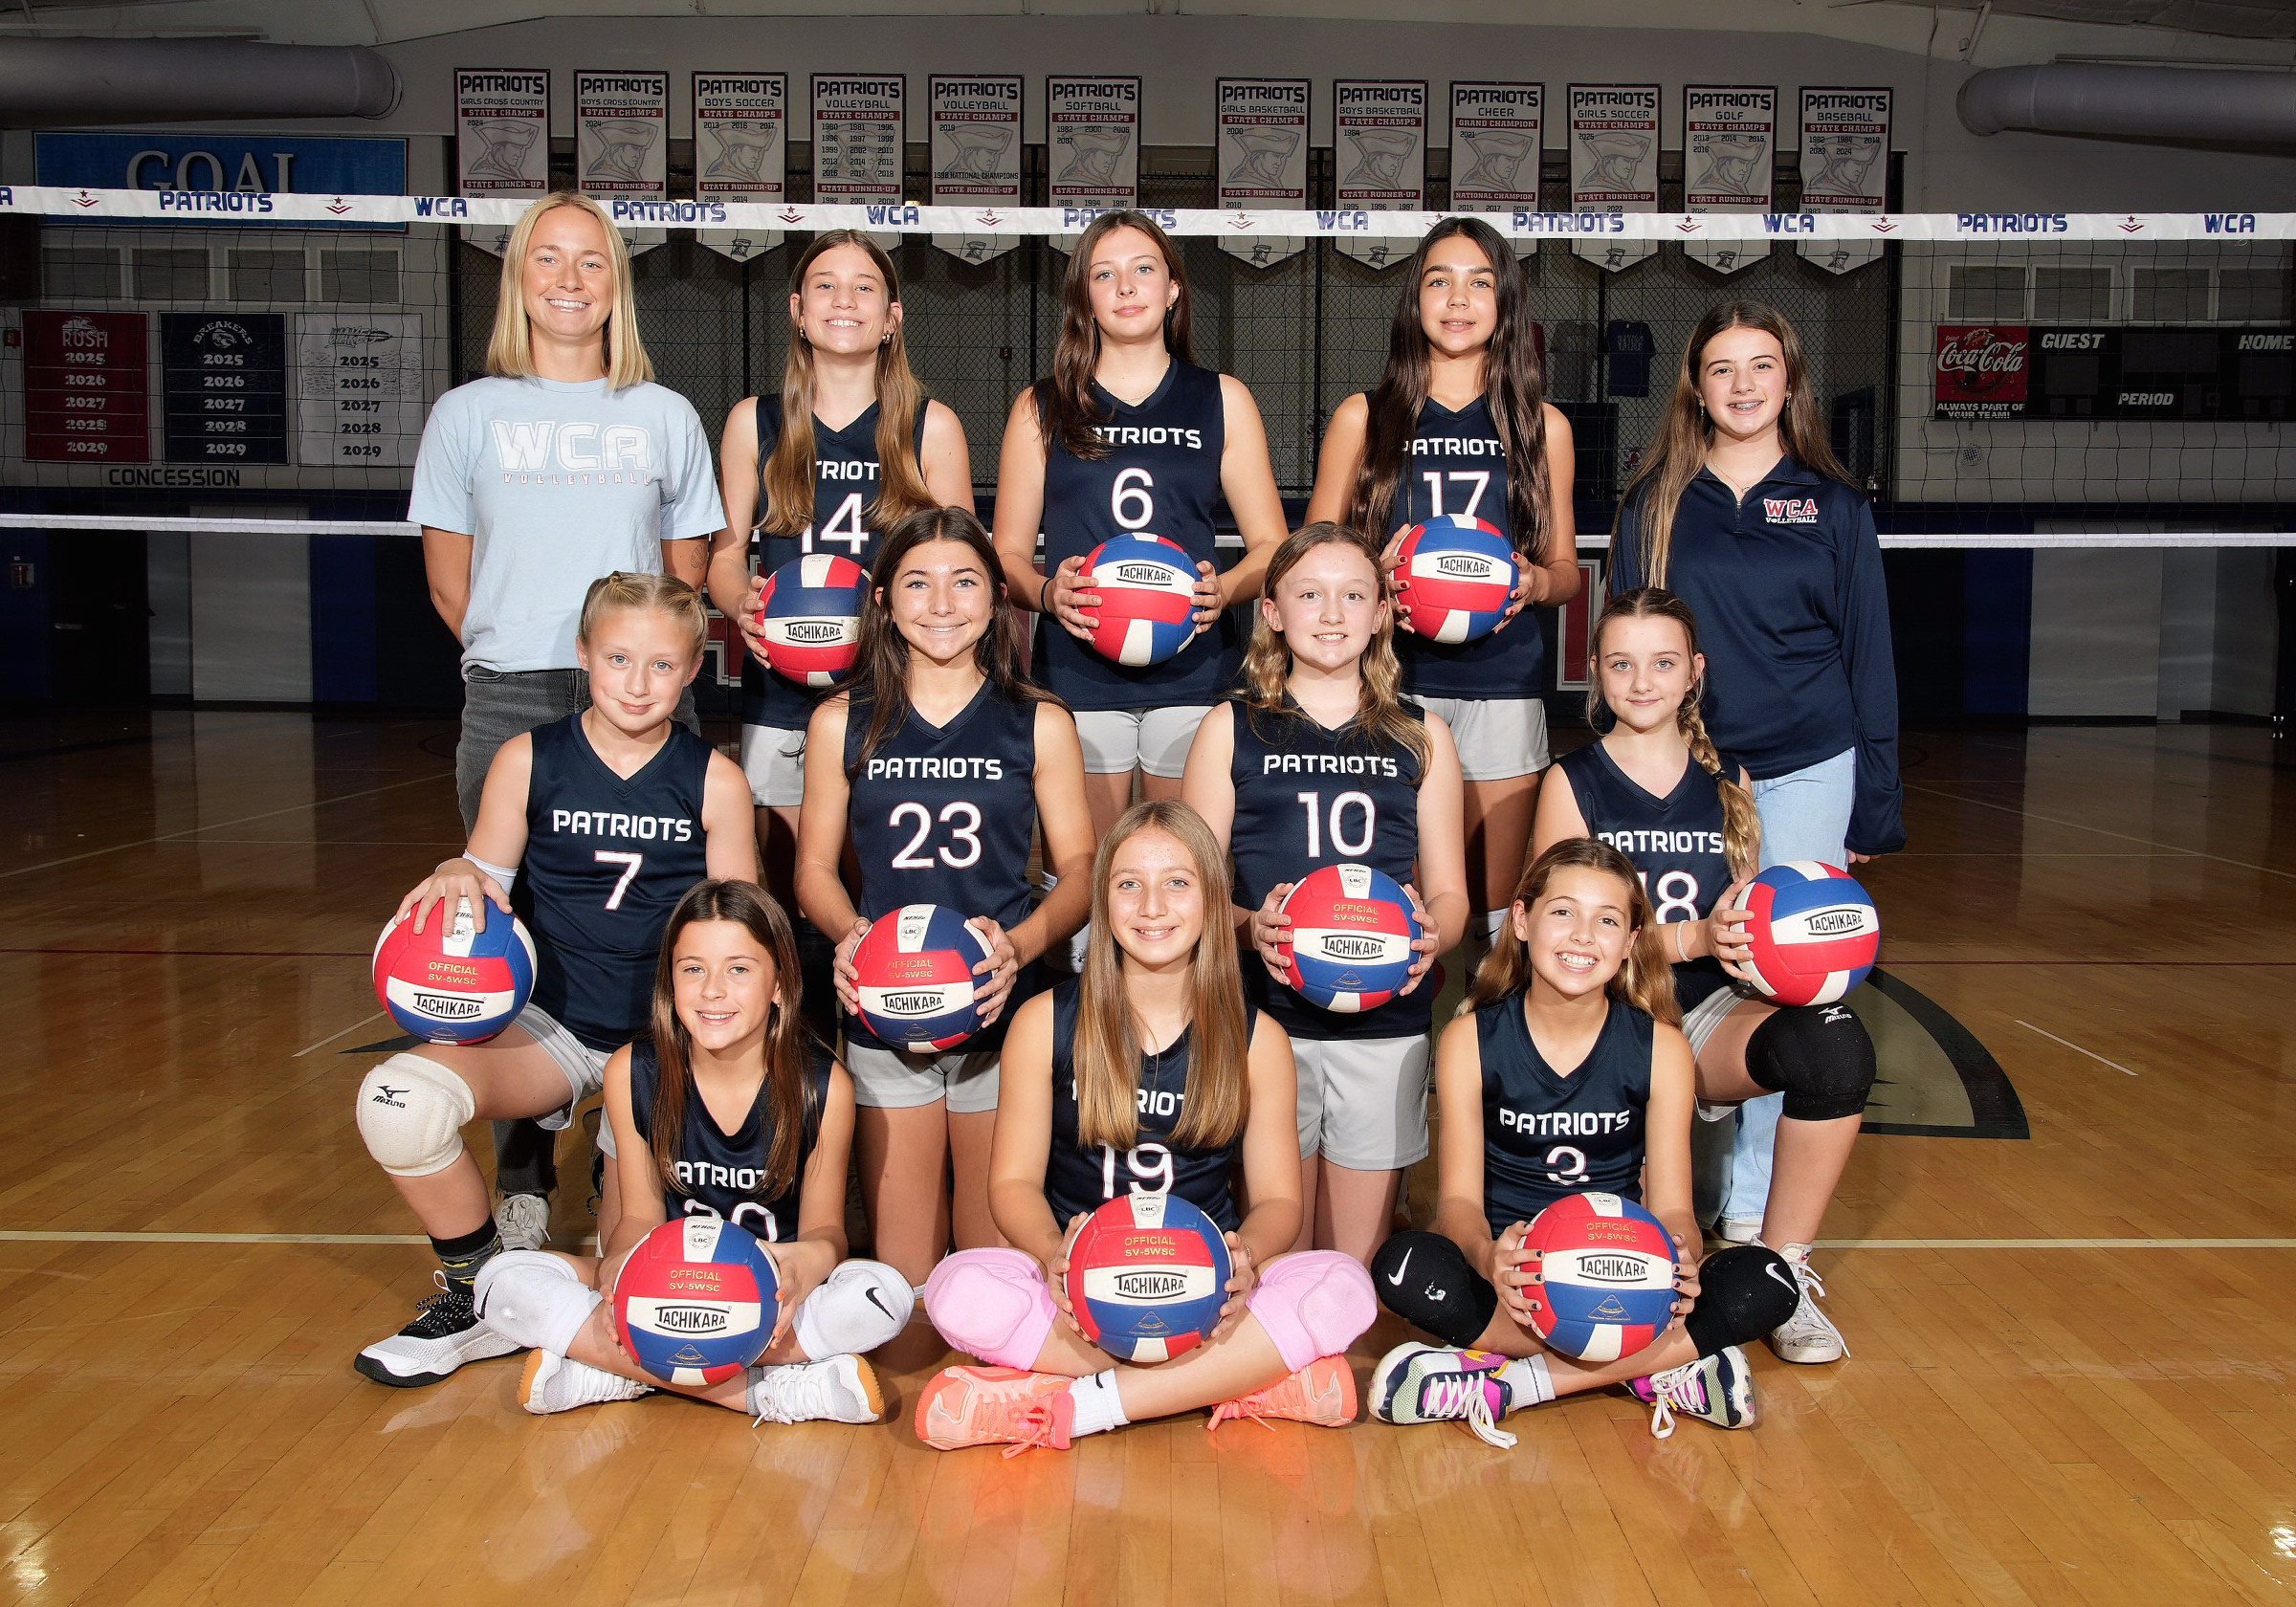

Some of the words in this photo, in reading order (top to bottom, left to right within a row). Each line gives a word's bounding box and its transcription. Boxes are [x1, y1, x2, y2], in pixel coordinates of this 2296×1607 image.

[460, 76, 544, 95] PATRIOTS
[581, 77, 663, 96] PATRIOTS
[698, 79, 782, 98] PATRIOTS
[817, 81, 899, 99] PATRIOTS
[935, 82, 1018, 99] PATRIOTS
[1052, 83, 1136, 101] PATRIOTS
[1222, 85, 1305, 103] PATRIOTS
[704, 99, 732, 107] BOYS
[736, 99, 775, 107] SOCCER
[826, 99, 890, 108] VOLLEYBALL
[1339, 87, 1423, 105] PATRIOTS
[1456, 89, 1538, 107] PATRIOTS
[1573, 91, 1656, 109] PATRIOTS
[1689, 93, 1772, 111] PATRIOTS
[1805, 95, 1888, 112] PATRIOTS
[499, 109, 538, 118] CHAMPS
[585, 108, 616, 117] STATE
[943, 100, 1008, 110] VOLLEYBALL
[1065, 101, 1121, 111] SOFTBALL
[1248, 105, 1305, 114] BASKETBALL
[1478, 107, 1514, 117] CHEER
[1610, 110, 1650, 119] SOCCER
[1715, 112, 1744, 121] GOLF
[1818, 113, 1873, 121] BASEBALL
[159, 191, 274, 212] PATRIOTS
[414, 197, 469, 218] WCA
[612, 201, 727, 222] PATRIOTS
[867, 206, 919, 227] WCA
[1064, 209, 1177, 230] PATS
[1316, 210, 1369, 231] WCA
[1512, 212, 1624, 232] PATRIOTS
[1762, 213, 1815, 233] WCA
[1956, 213, 2068, 233] PATRIOTS
[2204, 213, 2256, 233] WCA
[193, 320, 253, 344] BREAKERS
[2042, 333, 2106, 349] GUEST
[2239, 335, 2294, 350] HOME
[65, 352, 105, 364] 2025
[203, 354, 244, 365] 2025
[340, 356, 380, 367] 2025
[204, 376, 245, 387] 2026
[341, 378, 381, 389] 2026
[65, 397, 106, 409] 2027
[204, 398, 245, 410] 2027
[341, 401, 381, 412] 2027
[1937, 403, 1978, 411] ALWAYS
[1981, 403, 2009, 411] PART
[2012, 403, 2026, 411] OF
[2118, 392, 2175, 406] PERIOD
[206, 421, 247, 431] 2028
[342, 423, 381, 434] 2028
[490, 420, 651, 473] WCA
[1093, 427, 1203, 450] TRIOTS
[207, 443, 247, 455] 2029
[342, 446, 382, 457] 2029
[108, 468, 240, 487] CONCESSION
[815, 461, 882, 480] RIOT
[503, 473, 651, 486] VOLLEYBALL
[1112, 467, 1155, 530] 6
[1423, 470, 1490, 517] 17
[1763, 498, 1819, 517] WCA
[1117, 564, 1173, 583] TACHIKARA
[1437, 556, 1492, 575] TACHIKARA
[784, 622, 843, 640] TACHIKARA
[868, 758, 1004, 781] PATRIOTS
[1264, 754, 1399, 778] PATRIOTS
[552, 809, 693, 842] PATRIOTS
[1297, 791, 1377, 858] 10
[889, 801, 982, 870] 23
[594, 849, 644, 912] 7
[1334, 904, 1379, 915] OFFICIAL
[1334, 914, 1379, 924] SV-5WSC
[1804, 910, 1864, 933] TACHIKARA
[1321, 936, 1384, 956] TACHIKARA
[429, 960, 478, 976] OFFICIAL
[428, 973, 477, 985] SV-5WSC
[413, 993, 482, 1017] TACHIKARA
[880, 993, 944, 1012] TACHIKARA
[1499, 1108, 1630, 1136] PATRIOTS
[674, 1161, 768, 1190] ATRIO
[1098, 1142, 1175, 1200] 19
[1586, 1222, 1638, 1234] OFFICIAL
[1124, 1236, 1176, 1246] OFFICIAL
[1587, 1233, 1638, 1244] SV-5WSC
[1125, 1247, 1176, 1257] SV-5WSC
[670, 1270, 722, 1282] OFFICIAL
[1577, 1257, 1647, 1278] TACHIKARA
[670, 1282, 719, 1292] SV-5WSC
[1114, 1274, 1186, 1295] TACHIKARA
[654, 1307, 728, 1330] TACHIKARA
